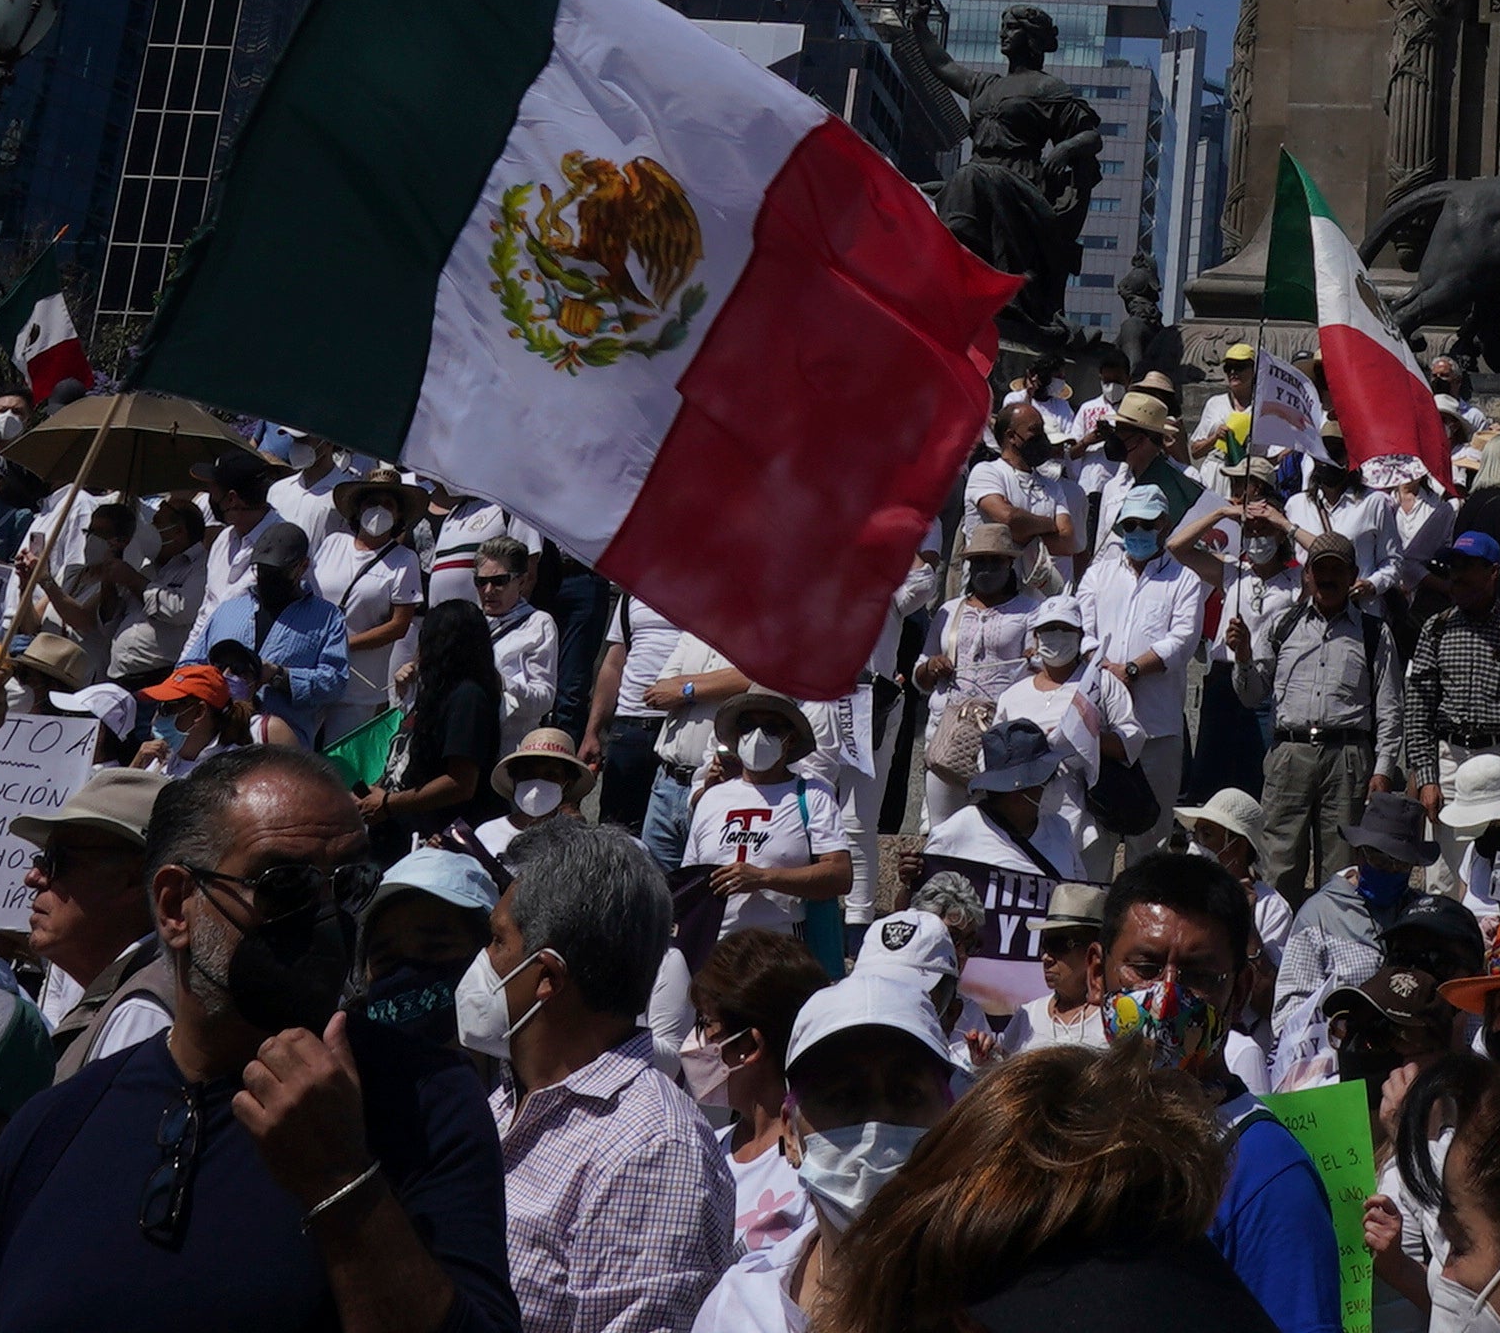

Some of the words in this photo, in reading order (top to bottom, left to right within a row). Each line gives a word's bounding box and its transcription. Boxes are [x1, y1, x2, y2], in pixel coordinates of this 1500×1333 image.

[720, 819, 769, 852] Tommy
[998, 913, 1021, 954] Y
[1026, 916, 1047, 957] T
[1284, 1112, 1318, 1132] 2024
[1322, 1153, 1342, 1173] EL
